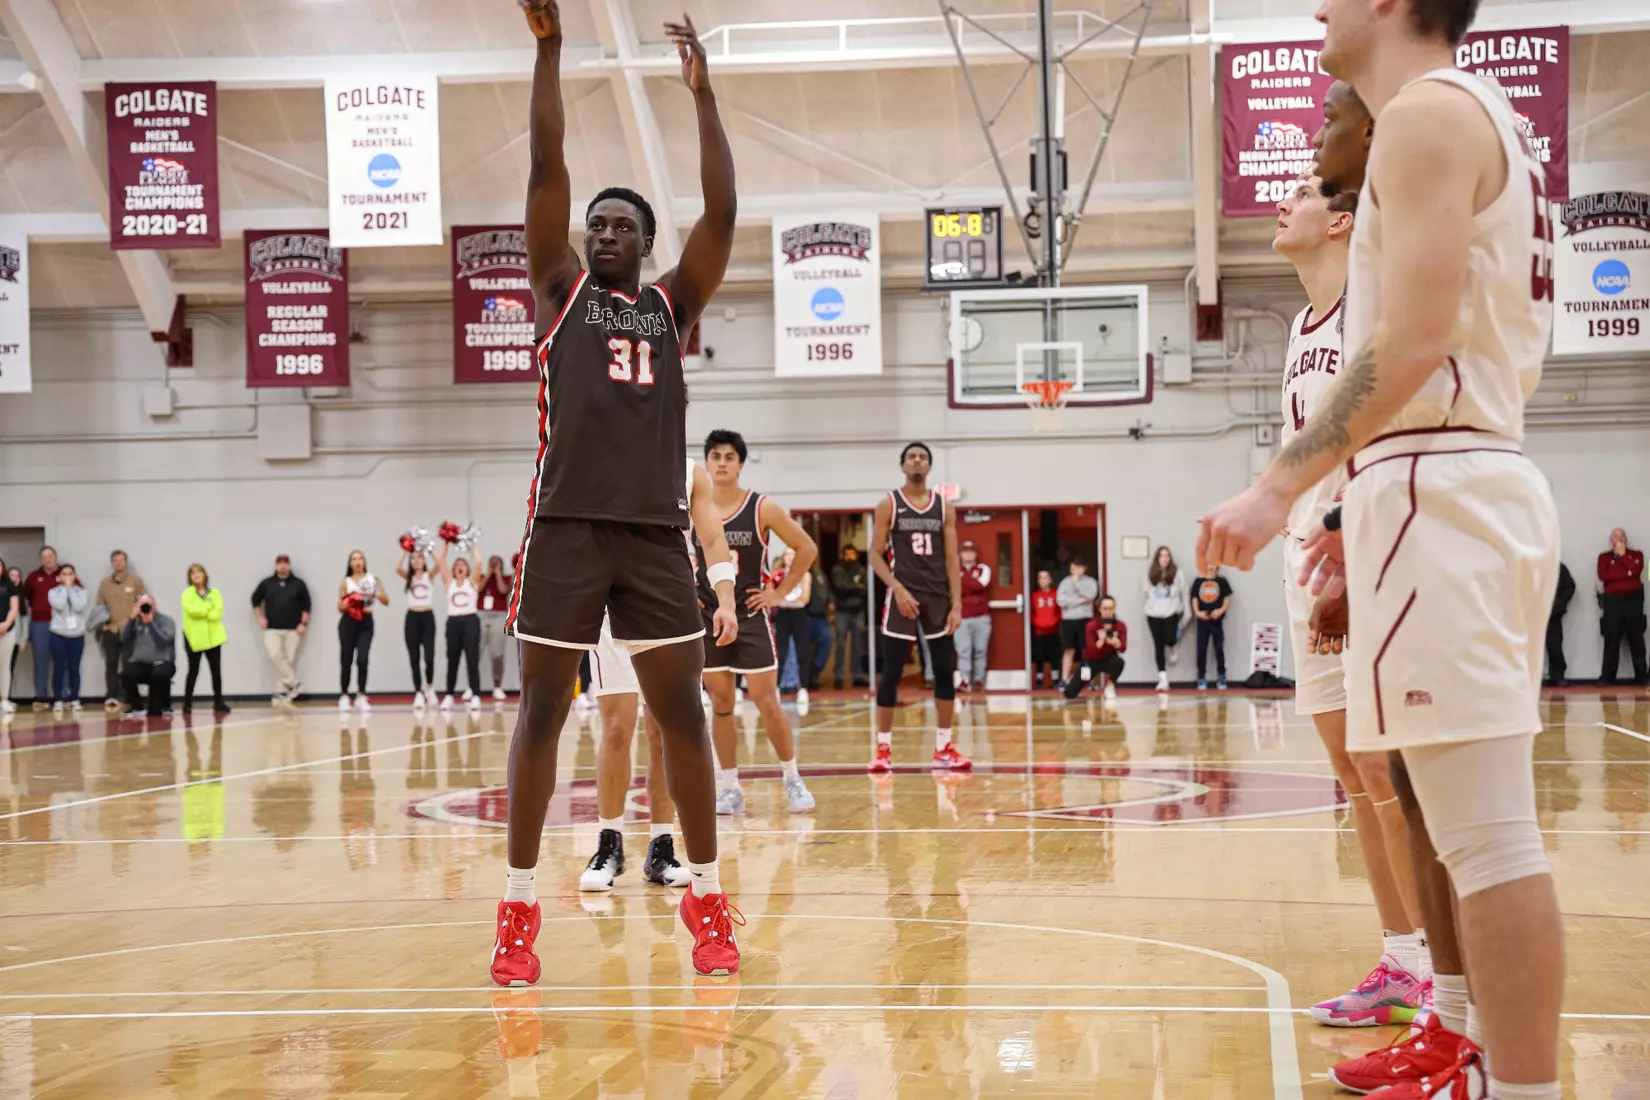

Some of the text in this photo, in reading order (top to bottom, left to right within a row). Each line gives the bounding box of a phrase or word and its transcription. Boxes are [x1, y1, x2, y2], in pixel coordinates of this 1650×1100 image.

[1456, 36, 1558, 68] COLGATE
[1476, 65, 1538, 77] RAIDERS
[1251, 77, 1311, 89] RAIDERS
[115, 89, 208, 117] COLGATE
[337, 86, 426, 111] COLGATE
[1248, 97, 1315, 111] VOLLEYBALL
[134, 117, 190, 127] RAIDERS
[145, 130, 179, 142] MEN'S
[367, 127, 397, 136] MEN'S
[130, 142, 195, 153] BASKETBALL
[352, 137, 413, 148] BASKETBALL
[1239, 161, 1313, 176] CHAMPION
[125, 185, 203, 197] TOURNAMENT
[1255, 180, 1298, 202] 202
[125, 196, 204, 210] CHAMPIONS
[342, 192, 427, 205] TOURNAMENT
[1561, 192, 1650, 223] COLGAT
[122, 214, 208, 236] 2020-21
[363, 212, 408, 229] 2021
[1573, 239, 1650, 252] VOLLEYBALL
[793, 268, 862, 280] VOLLEYBALL
[262, 281, 332, 294] VOLLEYBALL
[1596, 275, 1630, 288] NCAA
[266, 305, 328, 318] REGULAR
[1564, 300, 1650, 313] TOURNAMEN
[271, 319, 324, 332] SEASON
[465, 323, 535, 335] TOURNAMEN
[785, 325, 870, 338] TOURNAMENT
[1588, 318, 1639, 338] 1999
[258, 333, 336, 347] CHAMPIONS
[465, 333, 535, 347] CHAMPION
[807, 343, 853, 361] 1996
[276, 354, 323, 375] 1996
[483, 350, 531, 371] 1996
[608, 338, 655, 385] 31
[911, 532, 933, 555] 21
[451, 591, 469, 608] C
